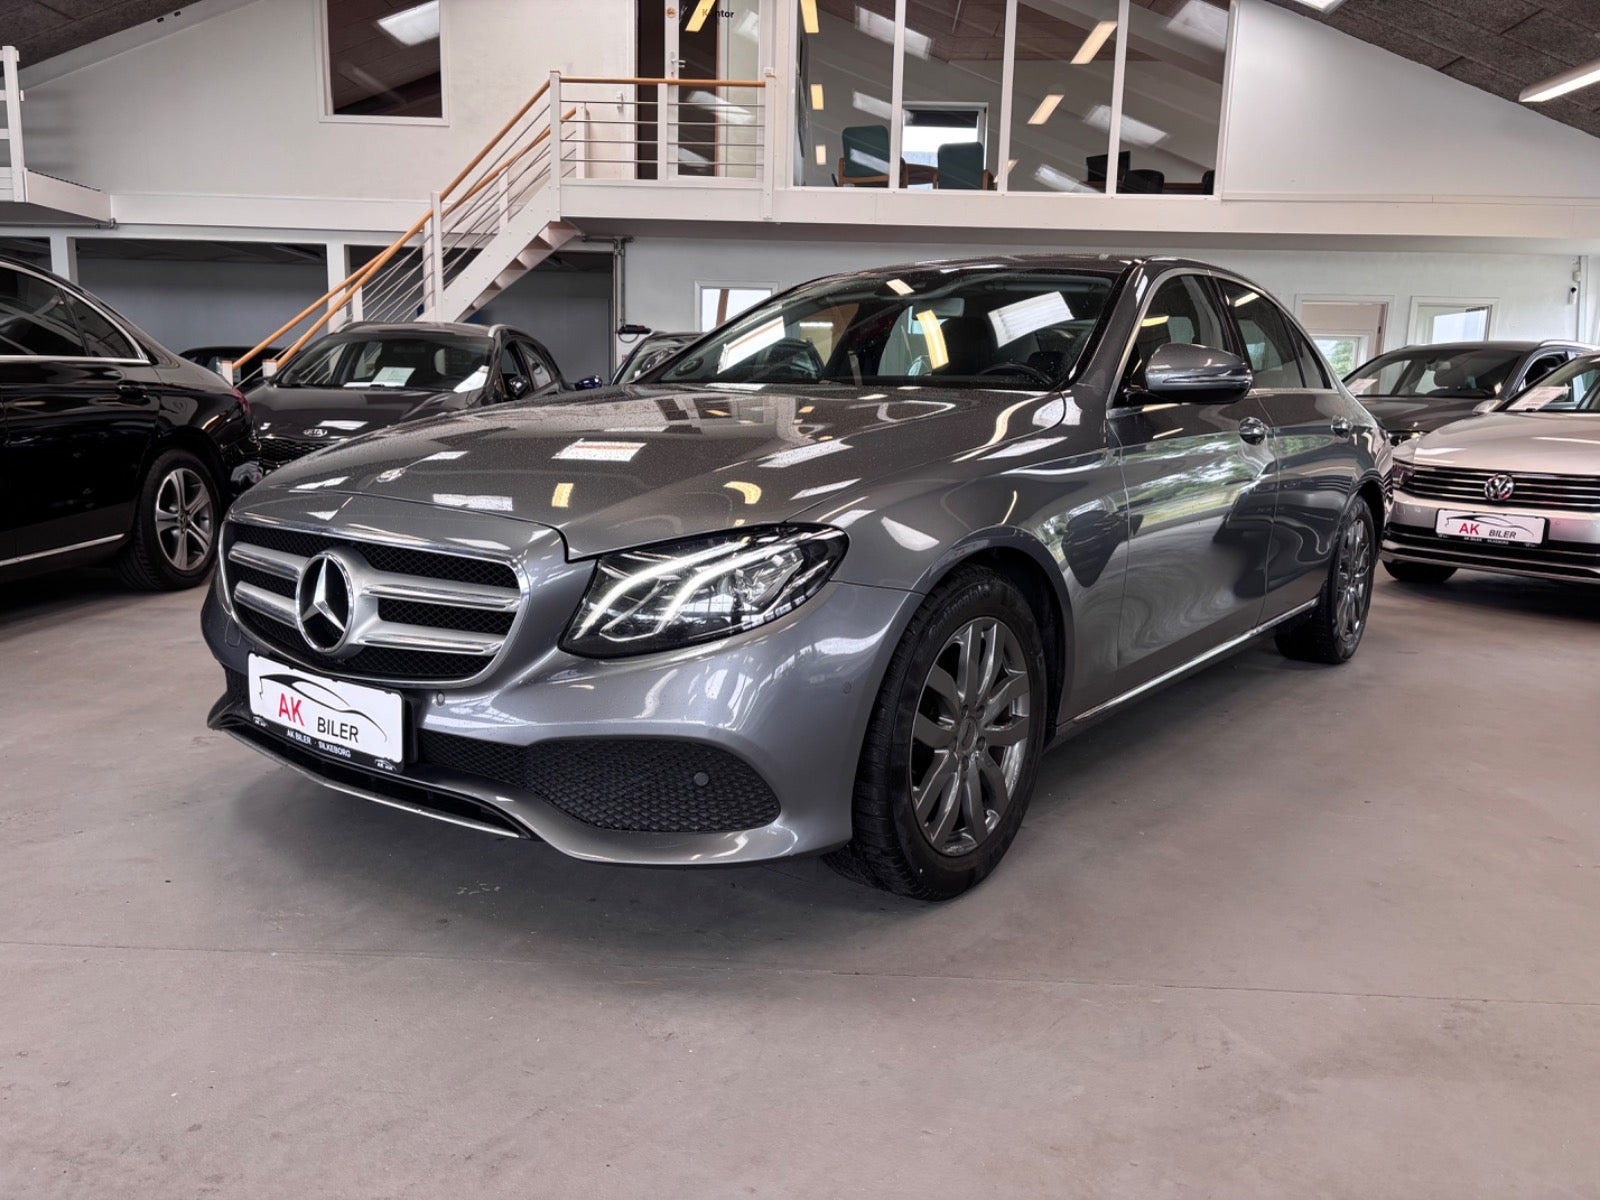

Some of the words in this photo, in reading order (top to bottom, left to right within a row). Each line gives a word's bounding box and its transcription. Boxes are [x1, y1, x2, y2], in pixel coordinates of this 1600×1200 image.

[702, 8, 734, 18] Kntor
[1459, 523, 1480, 535] AK
[1488, 529, 1517, 539] BILER
[278, 693, 305, 727] AK
[317, 716, 359, 743] BILER
[287, 728, 296, 739] AK
[295, 731, 312, 745] BILER
[318, 741, 351, 758] SILKEBORG
